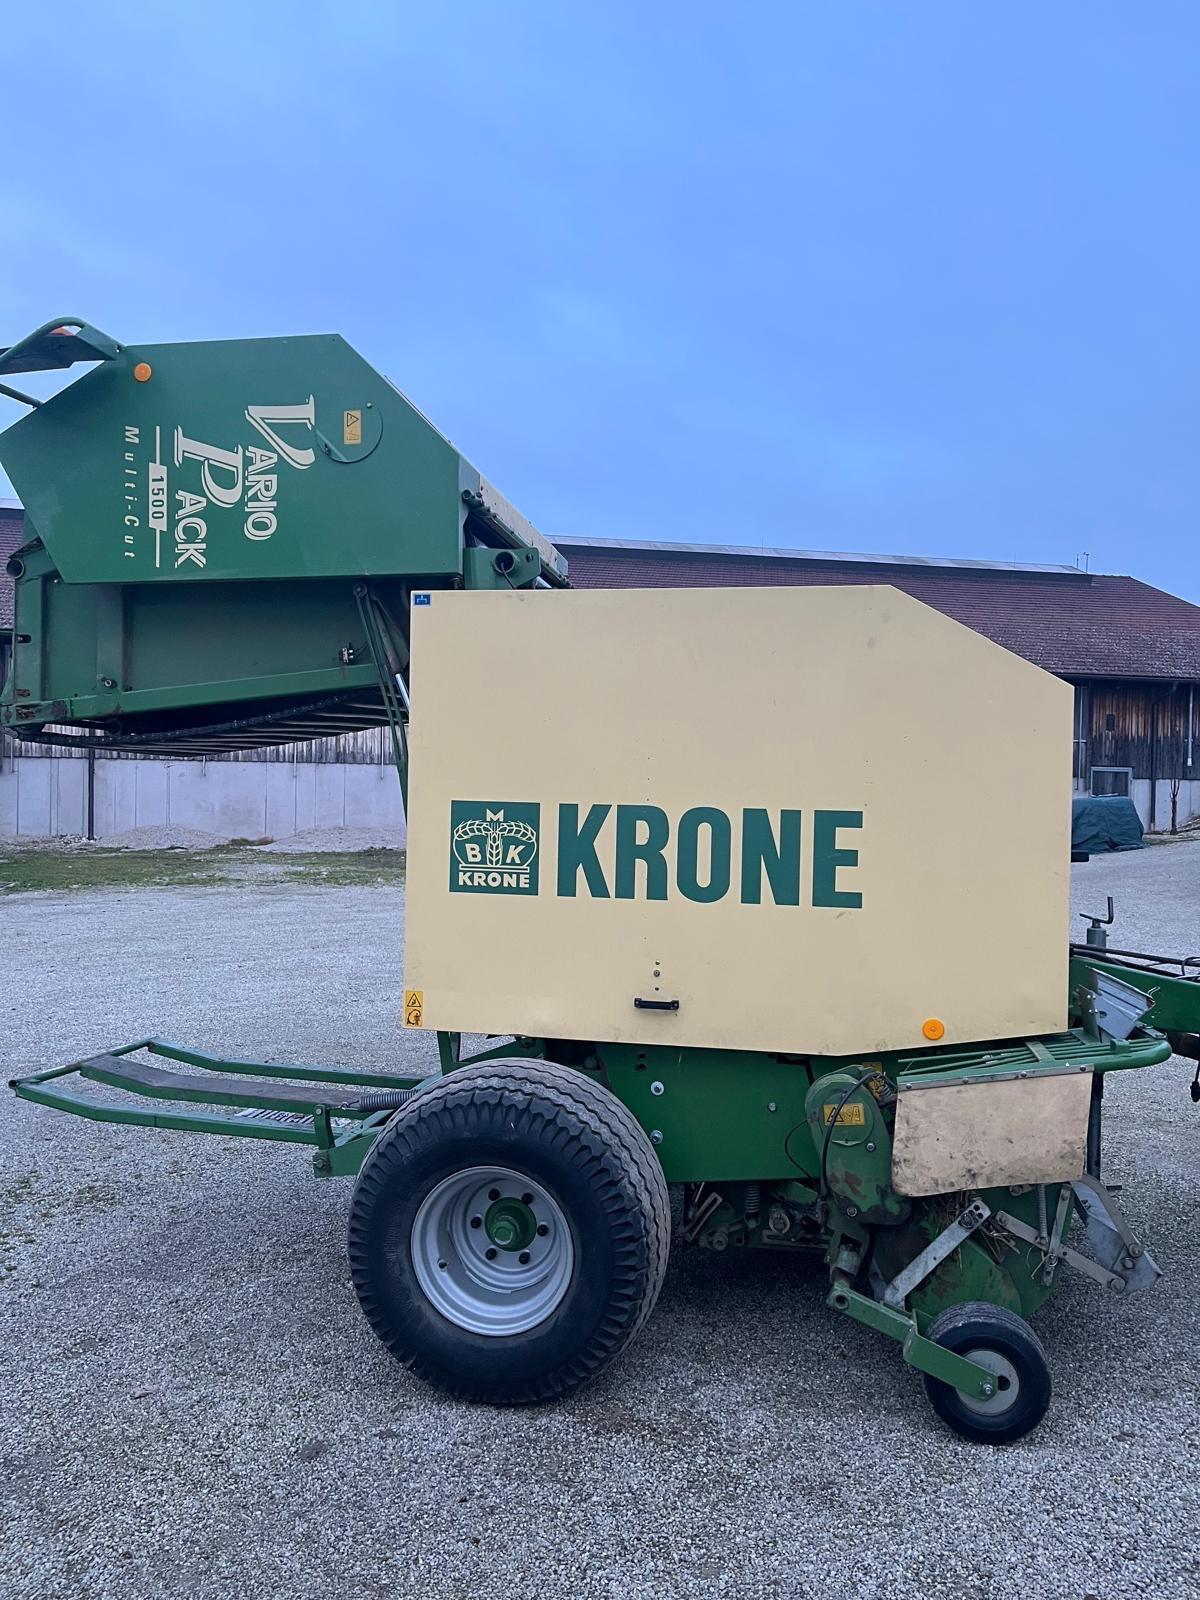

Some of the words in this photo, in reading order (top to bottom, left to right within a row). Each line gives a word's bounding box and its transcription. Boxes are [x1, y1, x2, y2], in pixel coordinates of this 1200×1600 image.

[124, 425, 140, 559] Multi-Cut
[151, 475, 166, 520] 1500
[174, 425, 244, 569] PACK
[245, 394, 316, 541] VARIO
[458, 871, 530, 888] KRONE
[465, 843, 482, 863] B
[505, 845, 526, 864] K
[556, 803, 864, 909] KRONE
